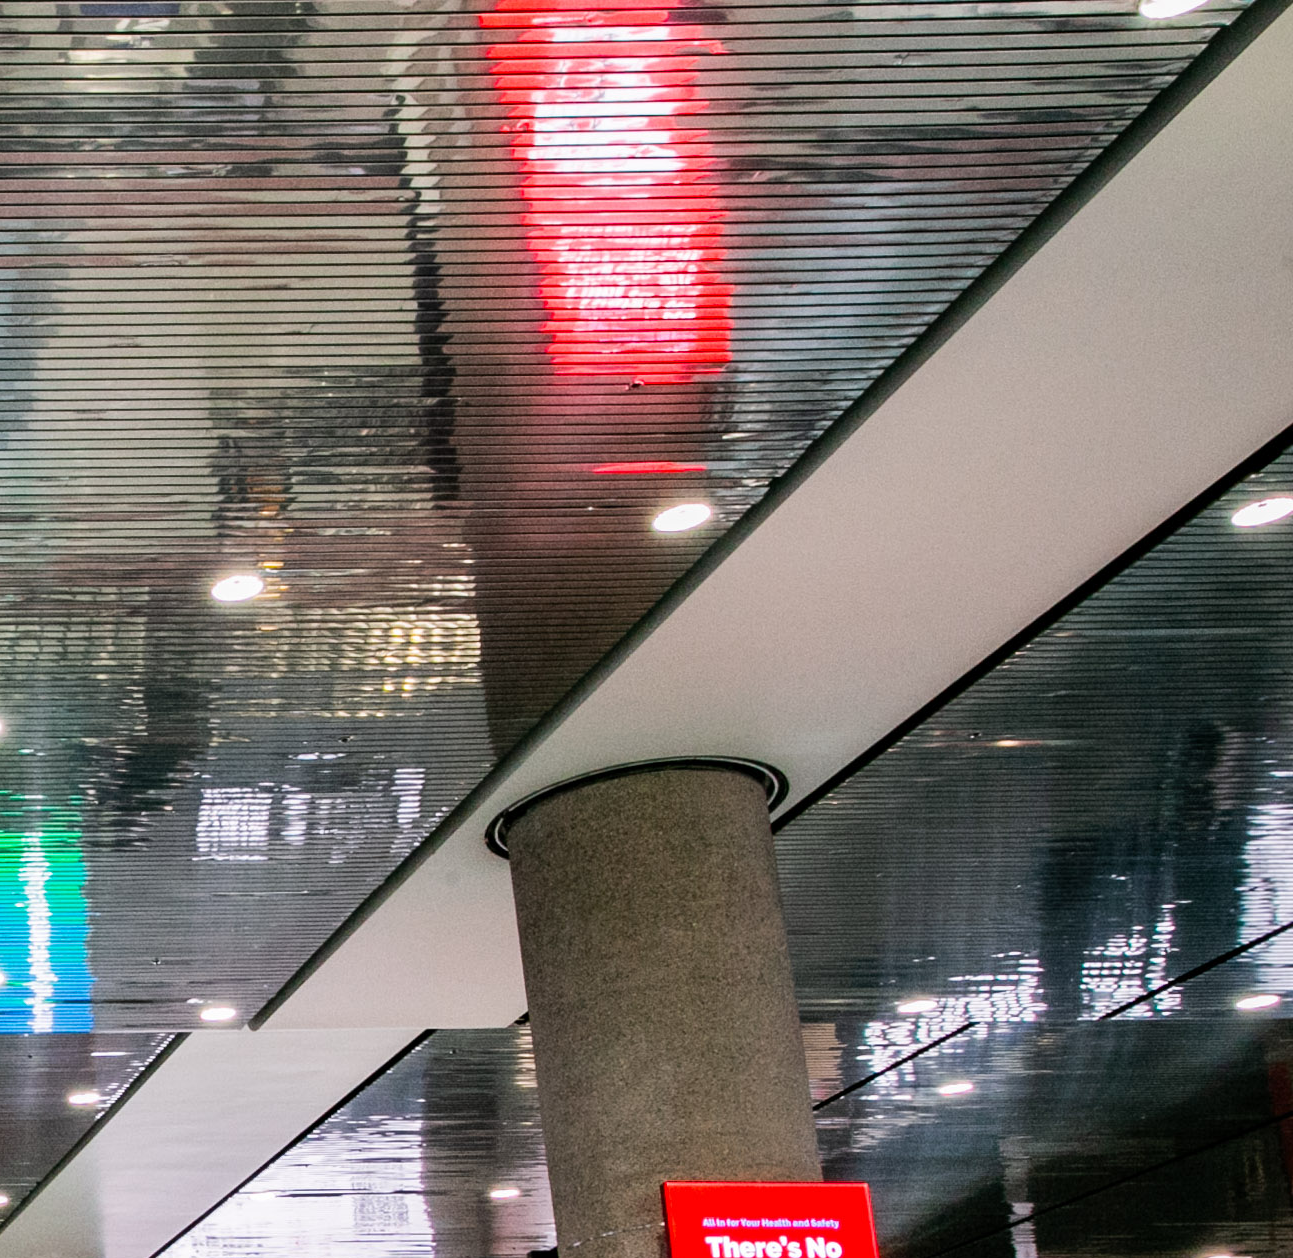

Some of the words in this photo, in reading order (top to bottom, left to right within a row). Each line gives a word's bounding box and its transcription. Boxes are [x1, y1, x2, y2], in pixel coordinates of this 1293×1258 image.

[762, 1218, 791, 1227] Health
[793, 1218, 809, 1227] and
[811, 1218, 839, 1229] Safety
[704, 1235, 802, 1258] There's
[805, 1236, 843, 1258] No
